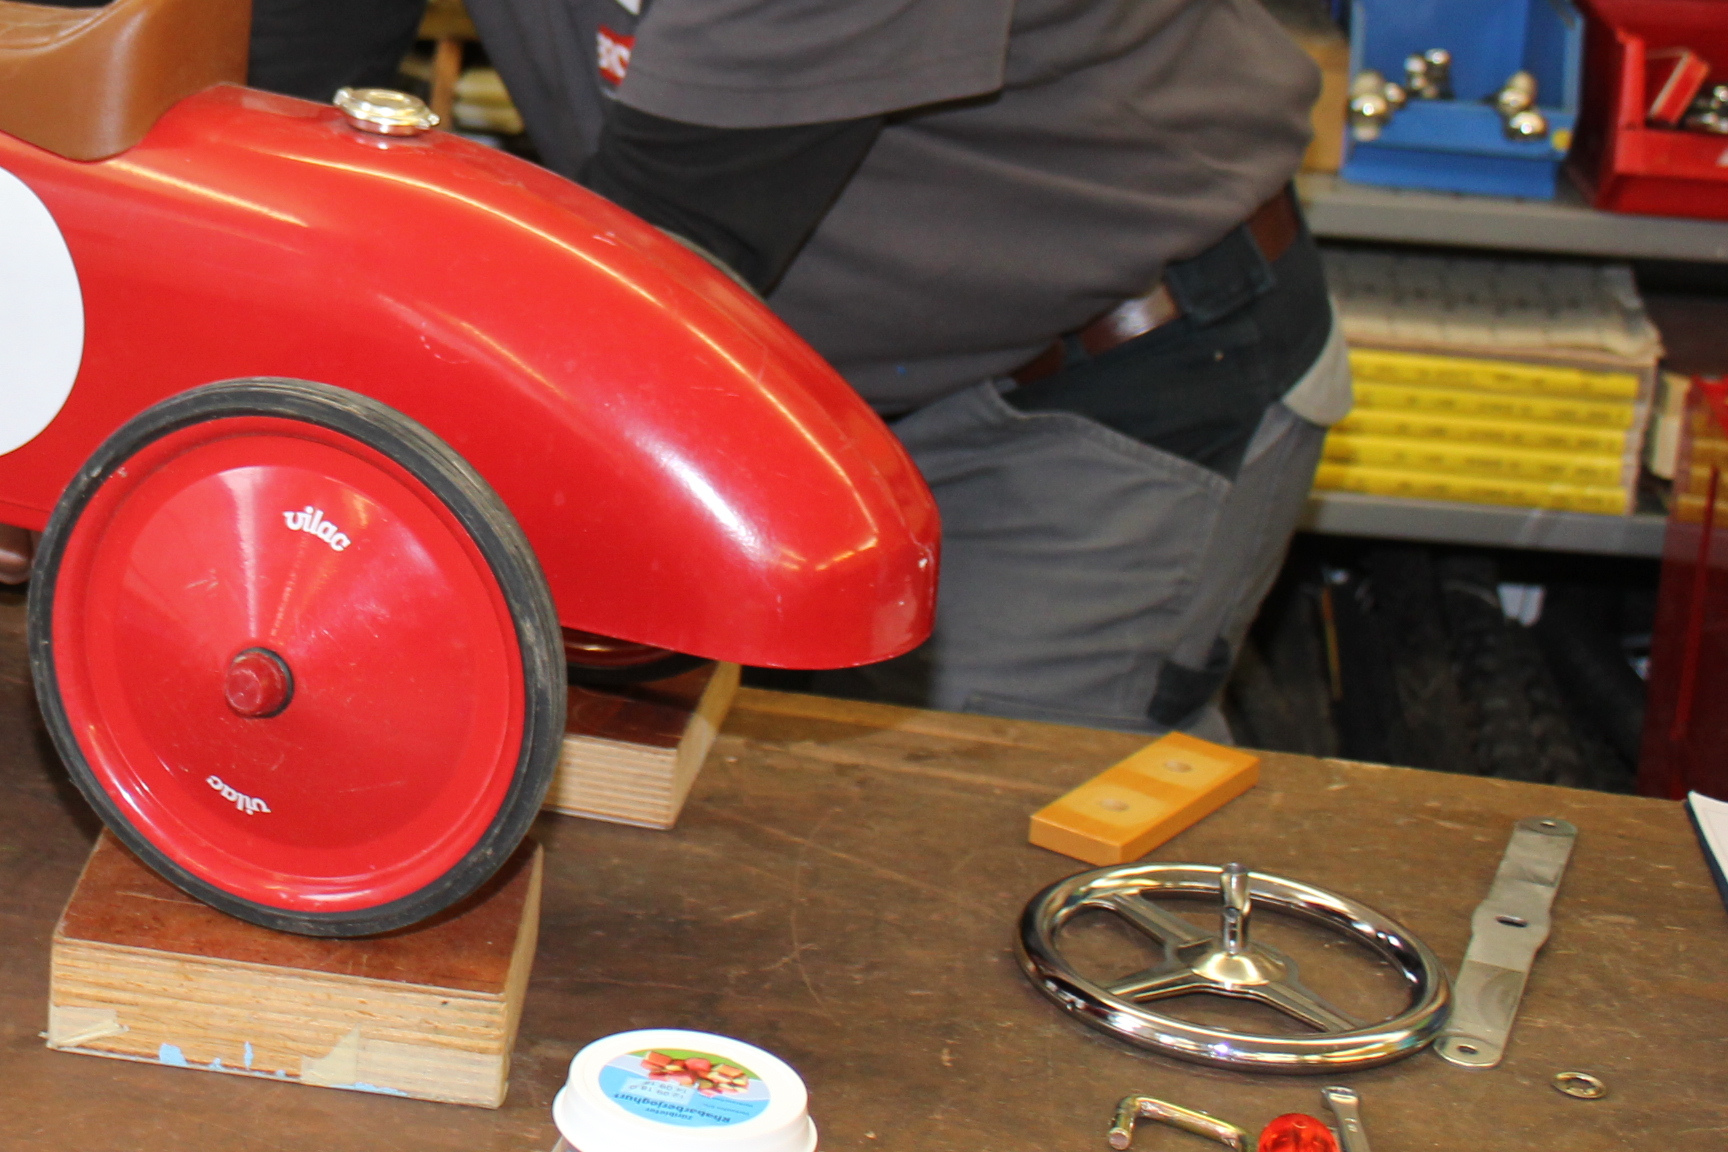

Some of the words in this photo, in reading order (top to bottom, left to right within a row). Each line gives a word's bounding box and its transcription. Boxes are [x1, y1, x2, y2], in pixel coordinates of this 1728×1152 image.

[282, 505, 352, 552] vilac
[205, 774, 272, 816] vilac
[614, 1093, 731, 1124] Rhabarberjoghurt
